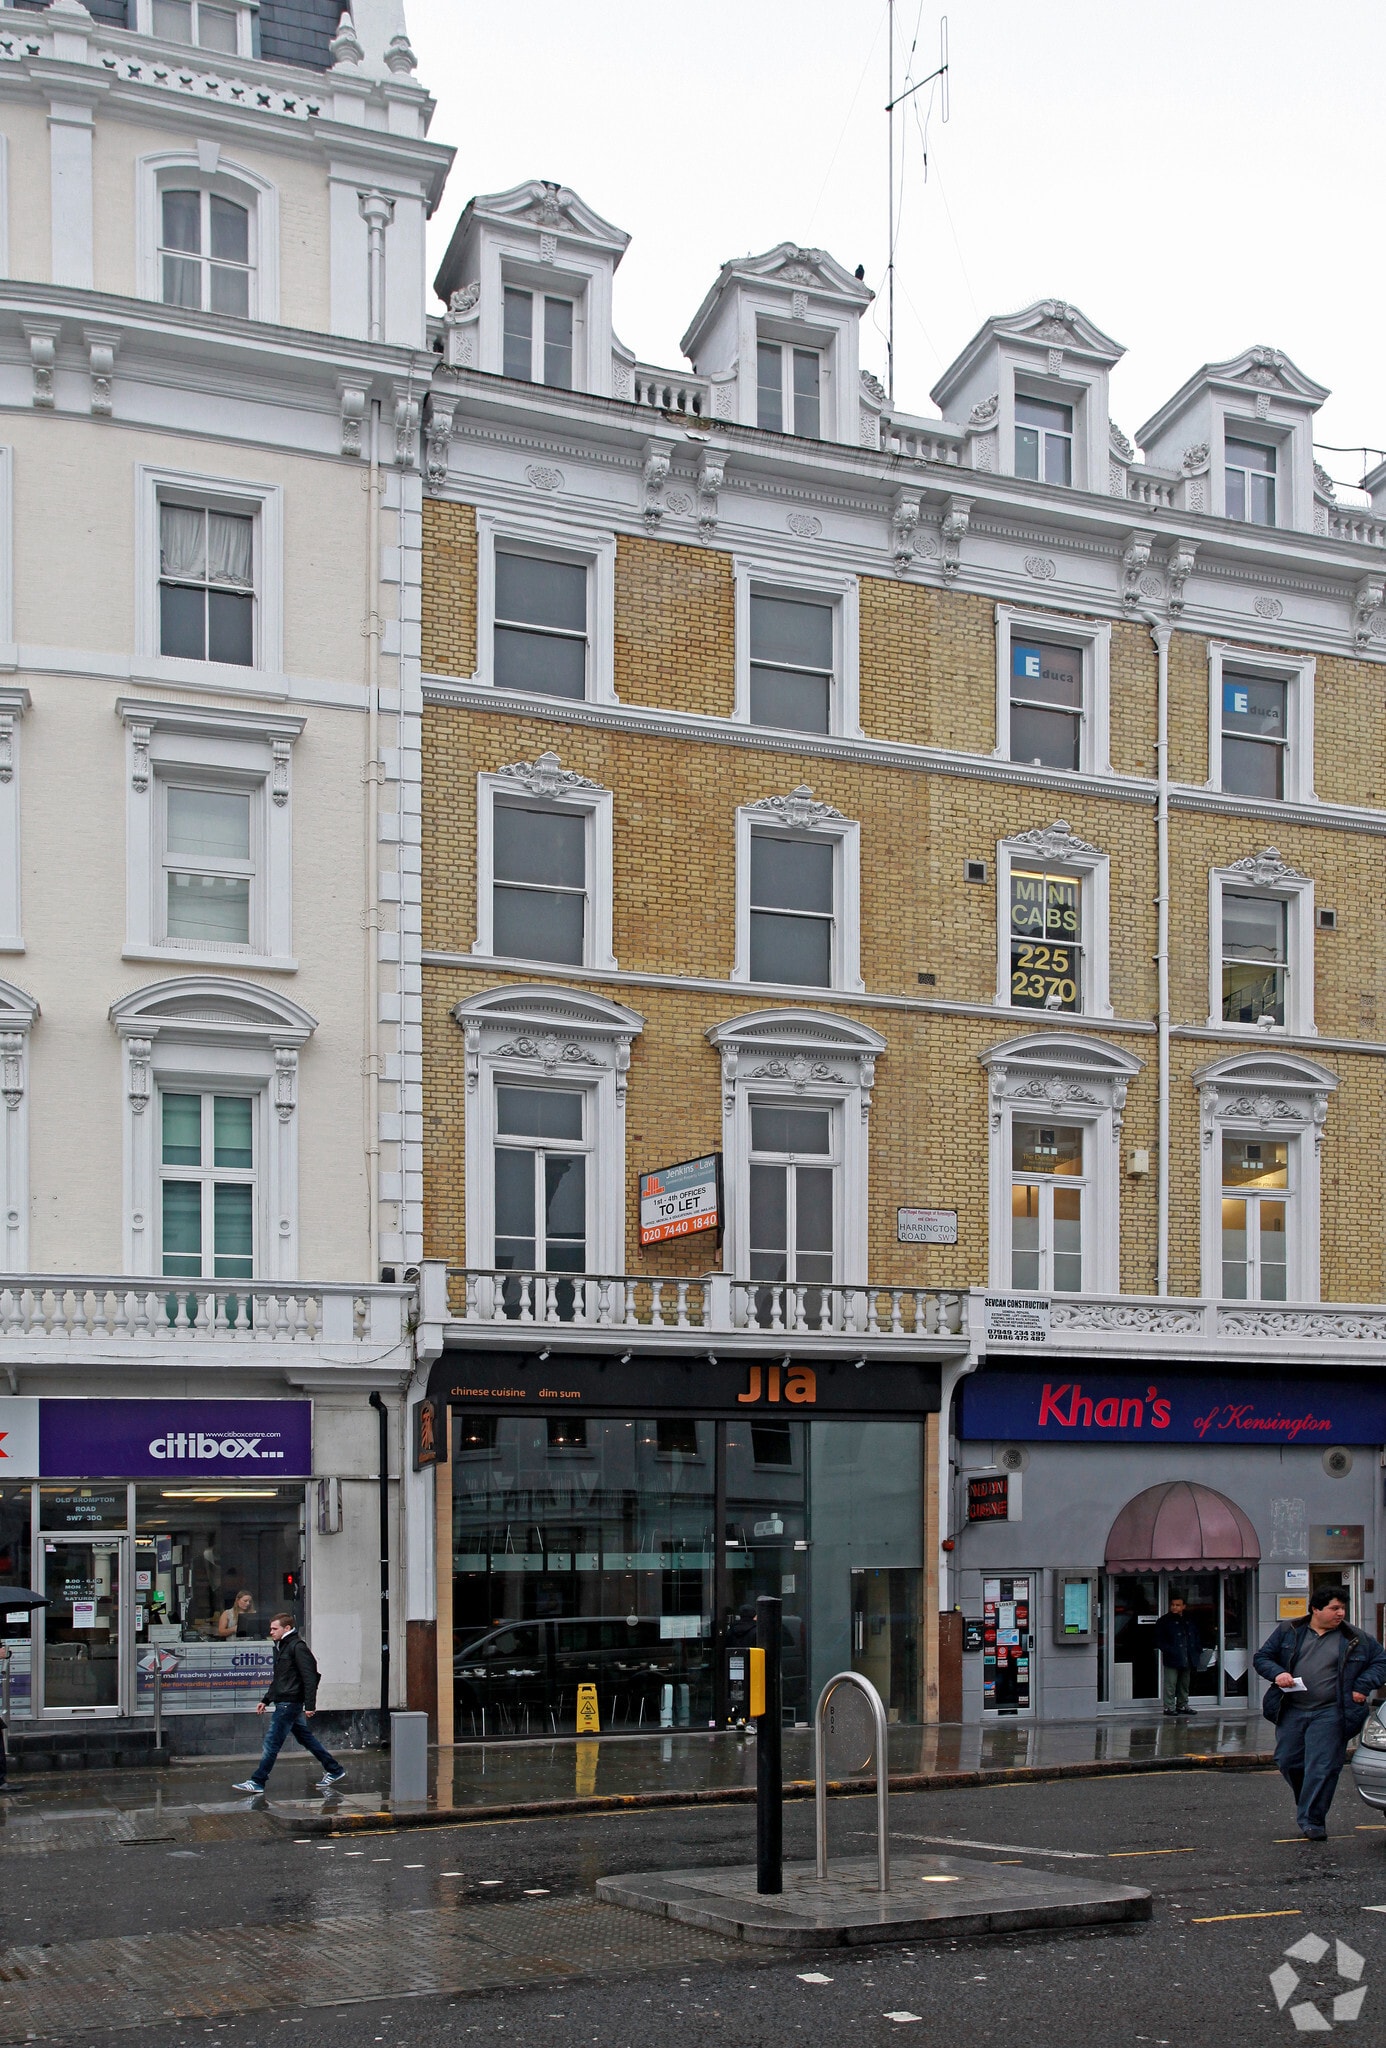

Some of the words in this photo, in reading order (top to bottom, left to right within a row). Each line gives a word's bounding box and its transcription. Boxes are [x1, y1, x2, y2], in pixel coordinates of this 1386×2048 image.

[1016, 880, 1072, 906] MINI
[1017, 943, 1069, 973] 225
[1012, 971, 1076, 1003] 2370
[666, 1166, 694, 1179] Jenkins
[668, 1194, 678, 1203] 4th
[679, 1187, 707, 1199] OFFICES
[659, 1203, 675, 1216] TO
[678, 1196, 701, 1212] LET
[643, 1228, 661, 1242] 020
[664, 1221, 689, 1237] 7440
[693, 1214, 717, 1229] 1840
[899, 1223, 956, 1233] HARRINGTON
[901, 1232, 927, 1240] ROAD
[985, 1298, 1007, 1308] SEVCAN
[1007, 1299, 1049, 1310] CONSTRUCTION
[451, 1386, 489, 1397] chinese
[491, 1387, 526, 1397] cuisine
[538, 1388, 558, 1398] dim
[560, 1389, 581, 1399] sum
[1038, 1383, 1171, 1429] Khan's
[1194, 1406, 1219, 1438] of
[1218, 1404, 1333, 1440] Kensington
[163, 1671, 179, 1679] mail
[172, 1680, 211, 1688] forwarding
